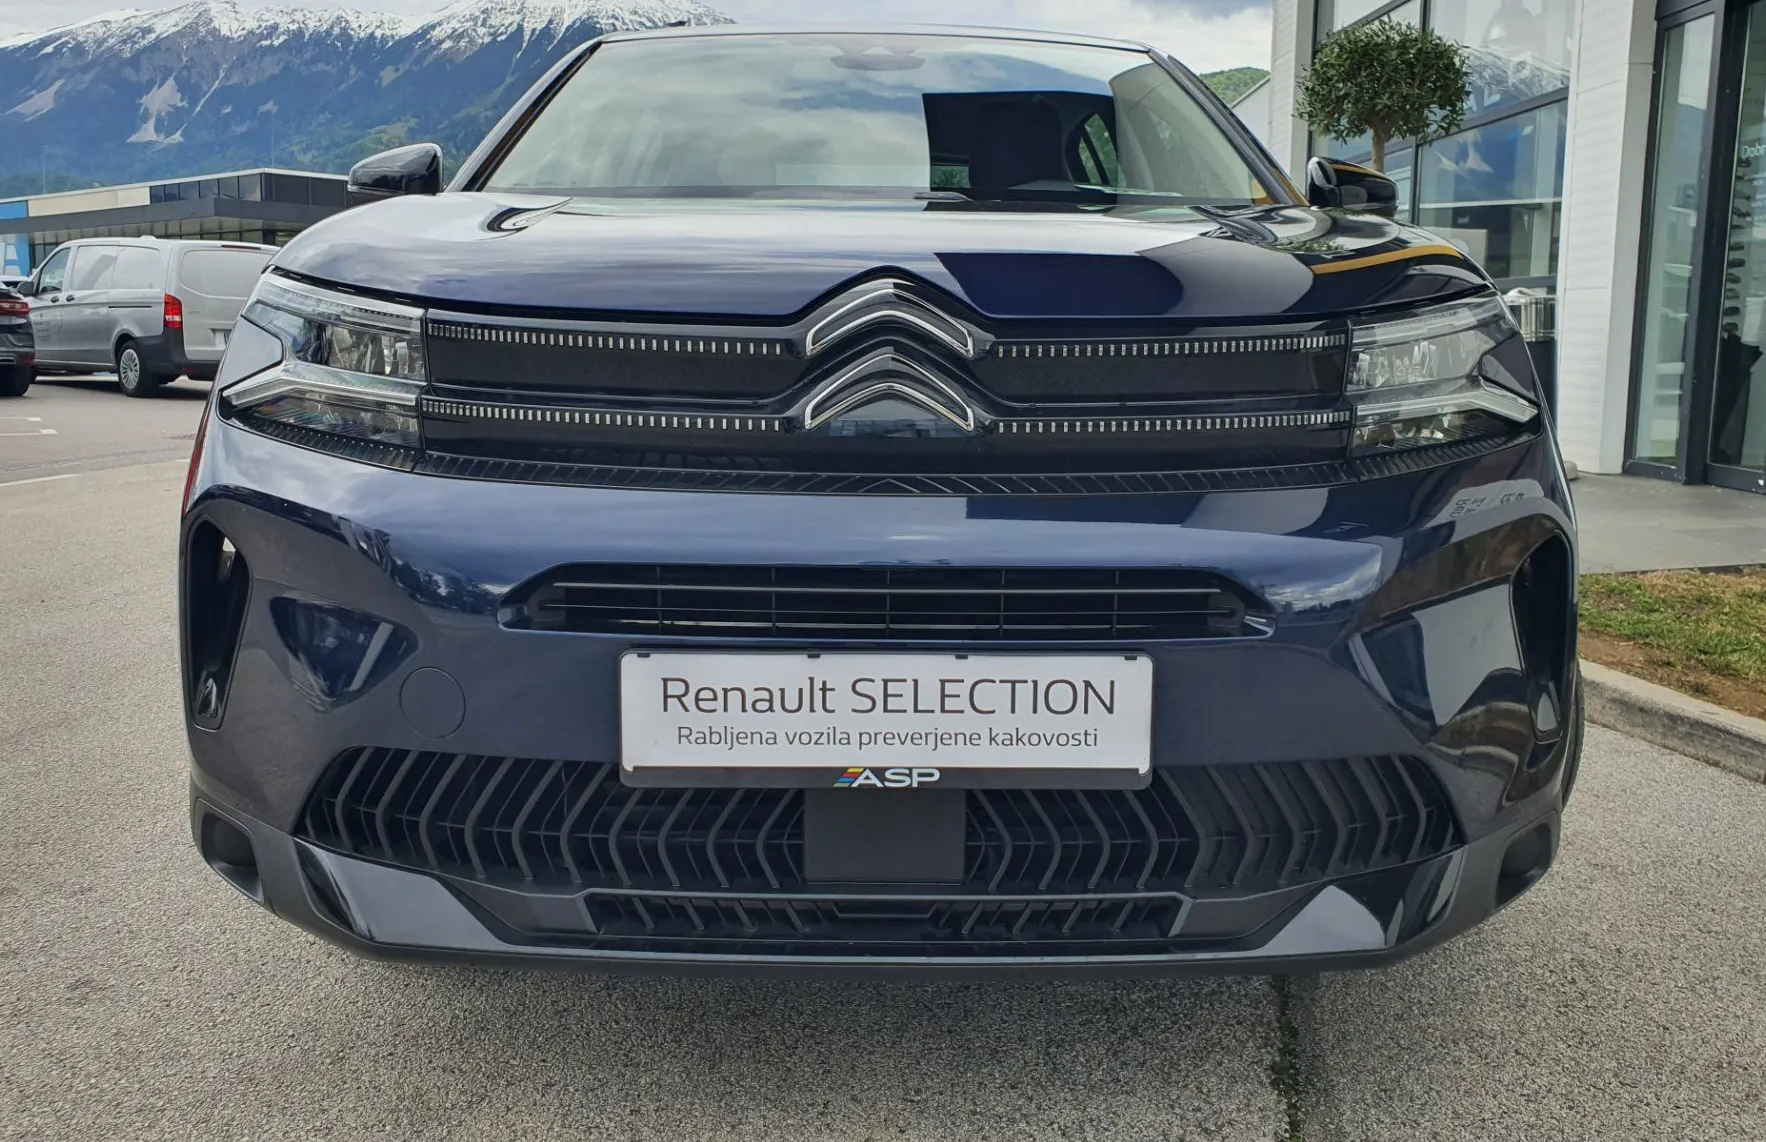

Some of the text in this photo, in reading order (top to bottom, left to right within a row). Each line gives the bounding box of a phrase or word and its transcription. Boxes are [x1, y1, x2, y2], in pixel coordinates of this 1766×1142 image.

[661, 676, 1116, 715] Renault SELECTION
[677, 726, 1098, 751] Rabljena vozila preverjene kakovosti
[850, 768, 941, 788] ASP
